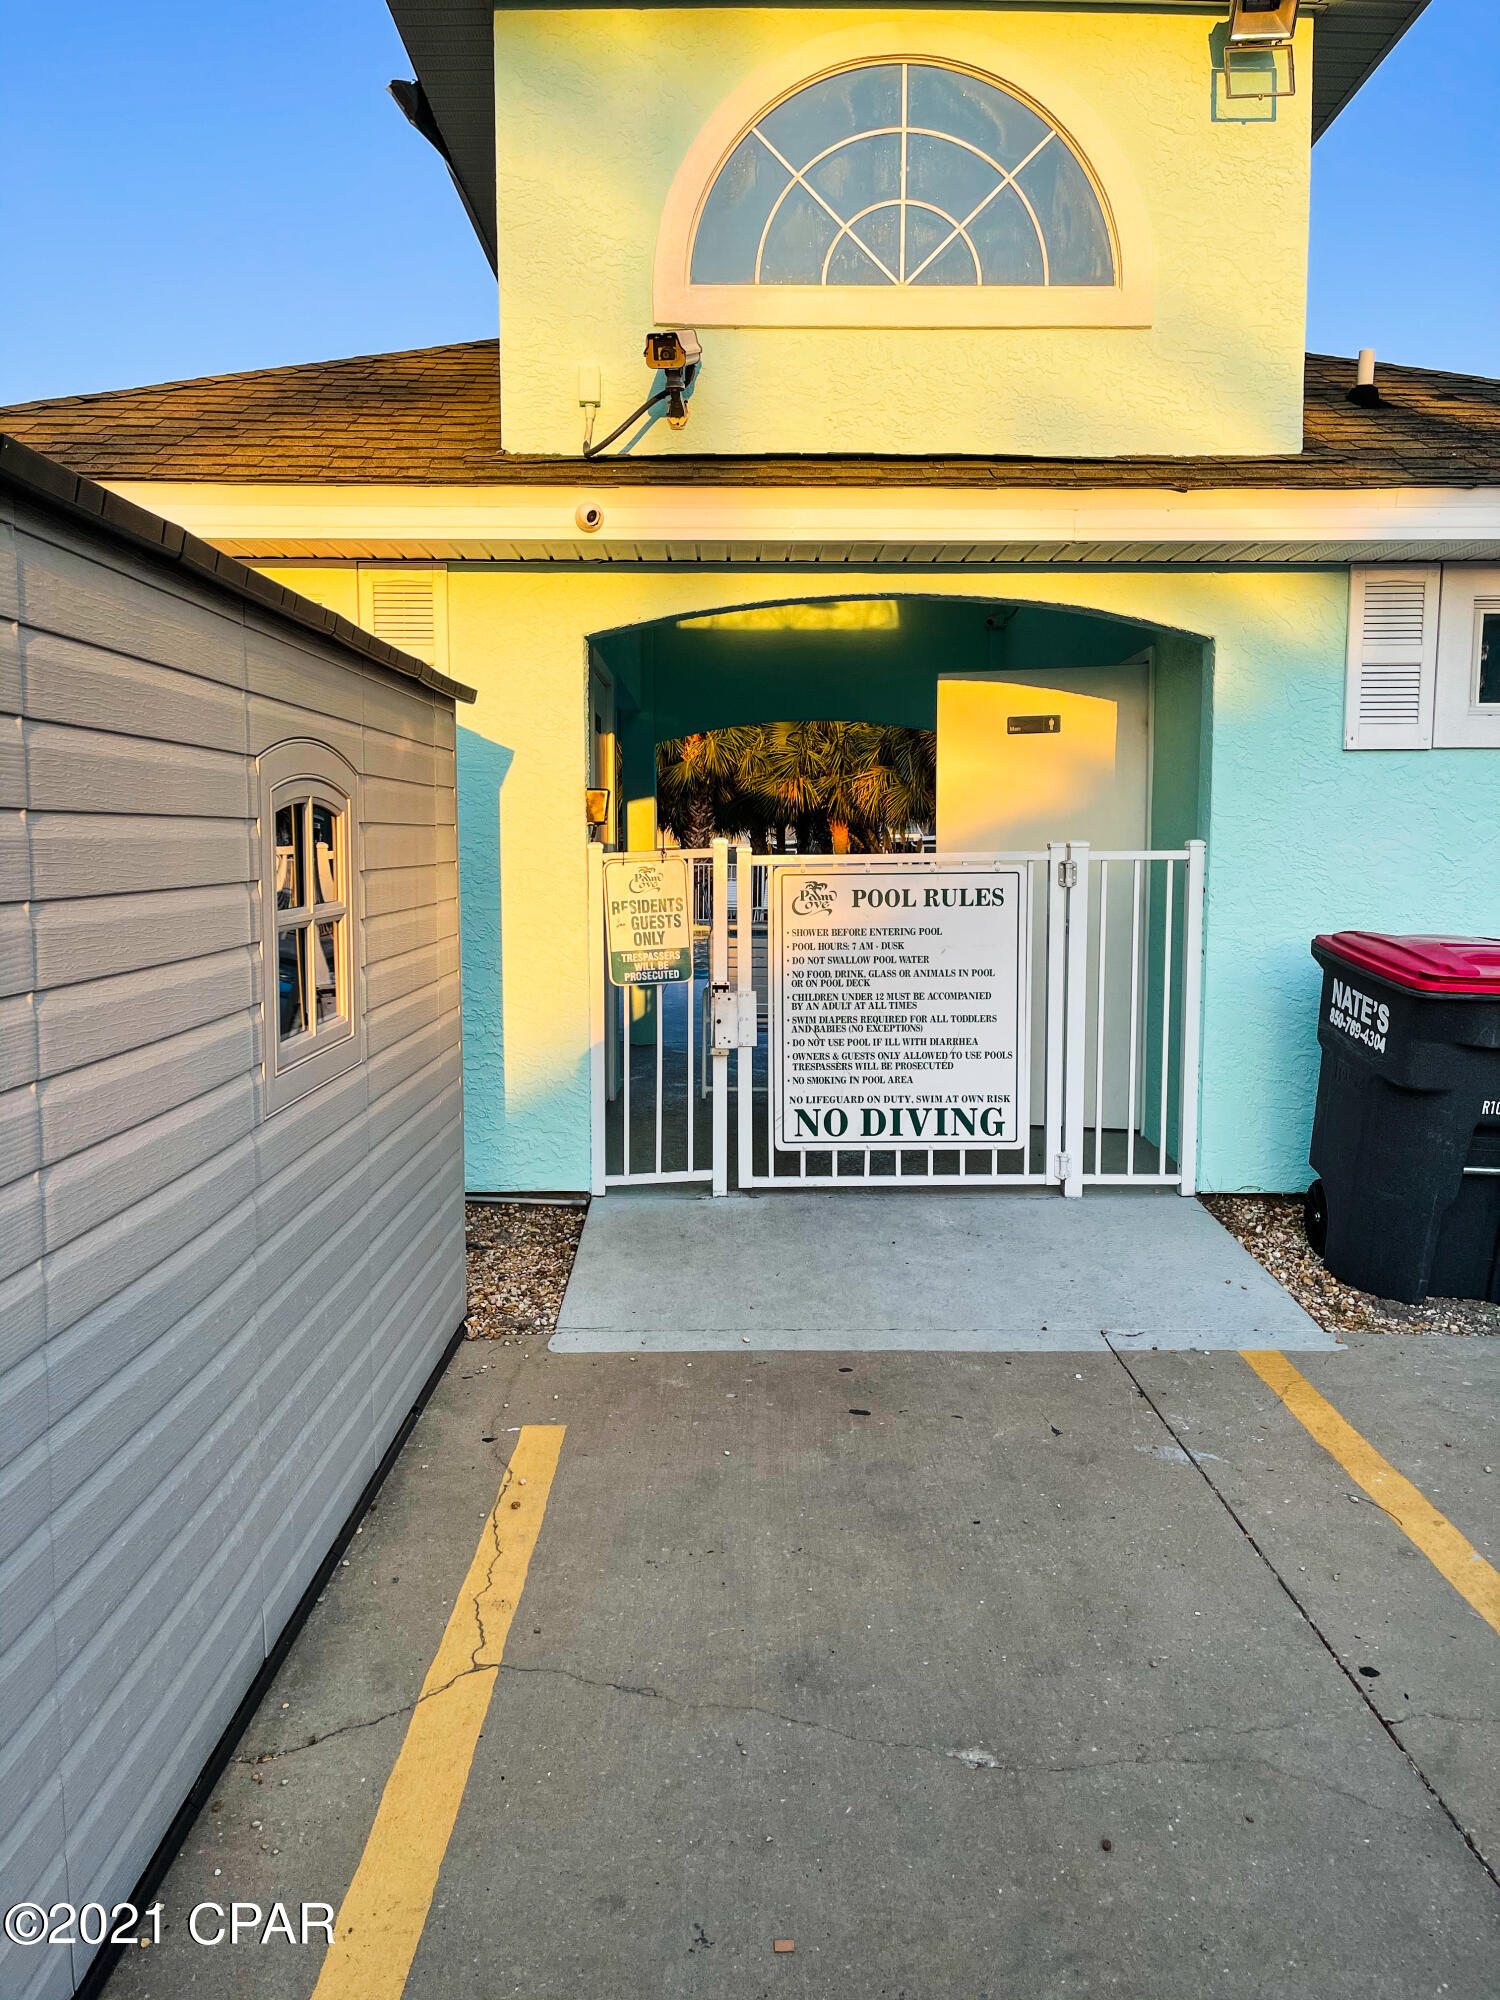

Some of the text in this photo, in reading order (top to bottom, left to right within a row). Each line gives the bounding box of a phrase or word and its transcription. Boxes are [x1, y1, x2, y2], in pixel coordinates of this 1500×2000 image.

[852, 887, 1004, 908] POOL RULES
[792, 896, 833, 916] Cove
[631, 914, 681, 930] GUESTS
[792, 928, 942, 936] SHOWER BEFORE ENTERING POOL
[634, 930, 665, 946] ONLY
[818, 942, 849, 950] HOURS:
[852, 942, 856, 950] 7
[859, 942, 873, 950] AM
[881, 942, 904, 950] DUSK
[621, 950, 680, 963] TRESPASSERS
[828, 956, 870, 964] SWALLOW
[873, 956, 896, 964] POOL
[634, 961, 669, 971] WILL BE
[624, 970, 680, 982] PROSECUTED
[868, 970, 896, 978] GLASS
[913, 969, 956, 977] ANIMALS
[959, 969, 968, 977] IN
[971, 969, 995, 977] POOL
[821, 979, 844, 987] POOL
[846, 979, 870, 987] DECK
[792, 993, 839, 1001] CHILDREN
[841, 993, 872, 1001] UNDER
[886, 992, 911, 1000] MUST
[913, 992, 925, 1000] BE
[927, 992, 992, 1000] ACCOMPANIED
[806, 1002, 819, 1010] AN
[822, 1002, 852, 1010] ADULT
[854, 1002, 865, 1010] AT
[868, 1002, 886, 1010] ALL
[889, 1001, 917, 1009] TIMES
[1332, 978, 1390, 1033] NATE'S
[792, 1015, 997, 1024] SWIM DIAPERS REQUIRED FOR ALL TODDLERS
[792, 1024, 923, 1034] AND BABIES (NO EXCEPTIONS)
[1330, 1007, 1386, 1054] 850-769-4304
[885, 1038, 900, 1046] ILL
[832, 1052, 839, 1060] &
[841, 1052, 875, 1060] GUESTS
[878, 1052, 900, 1060] ONLY
[950, 1051, 962, 1059] TO
[965, 1051, 982, 1059] USE
[984, 1051, 1013, 1059] POOLS
[792, 1063, 852, 1071] TRESPASSERS
[881, 1062, 892, 1070] BE
[895, 1062, 954, 1070] PROSECUTED
[806, 1076, 846, 1084] SMOKING
[849, 1076, 859, 1084] IN
[862, 1076, 885, 1084] POOL
[887, 1076, 913, 1084] AREA
[789, 1096, 803, 1104] NO
[806, 1096, 864, 1104] LIFEGUARD
[916, 1095, 942, 1103] SWIM
[946, 1095, 959, 1103] AT
[962, 1095, 984, 1103] OWN
[987, 1095, 1011, 1103] RISK
[794, 1107, 1005, 1137] NO DIVING
